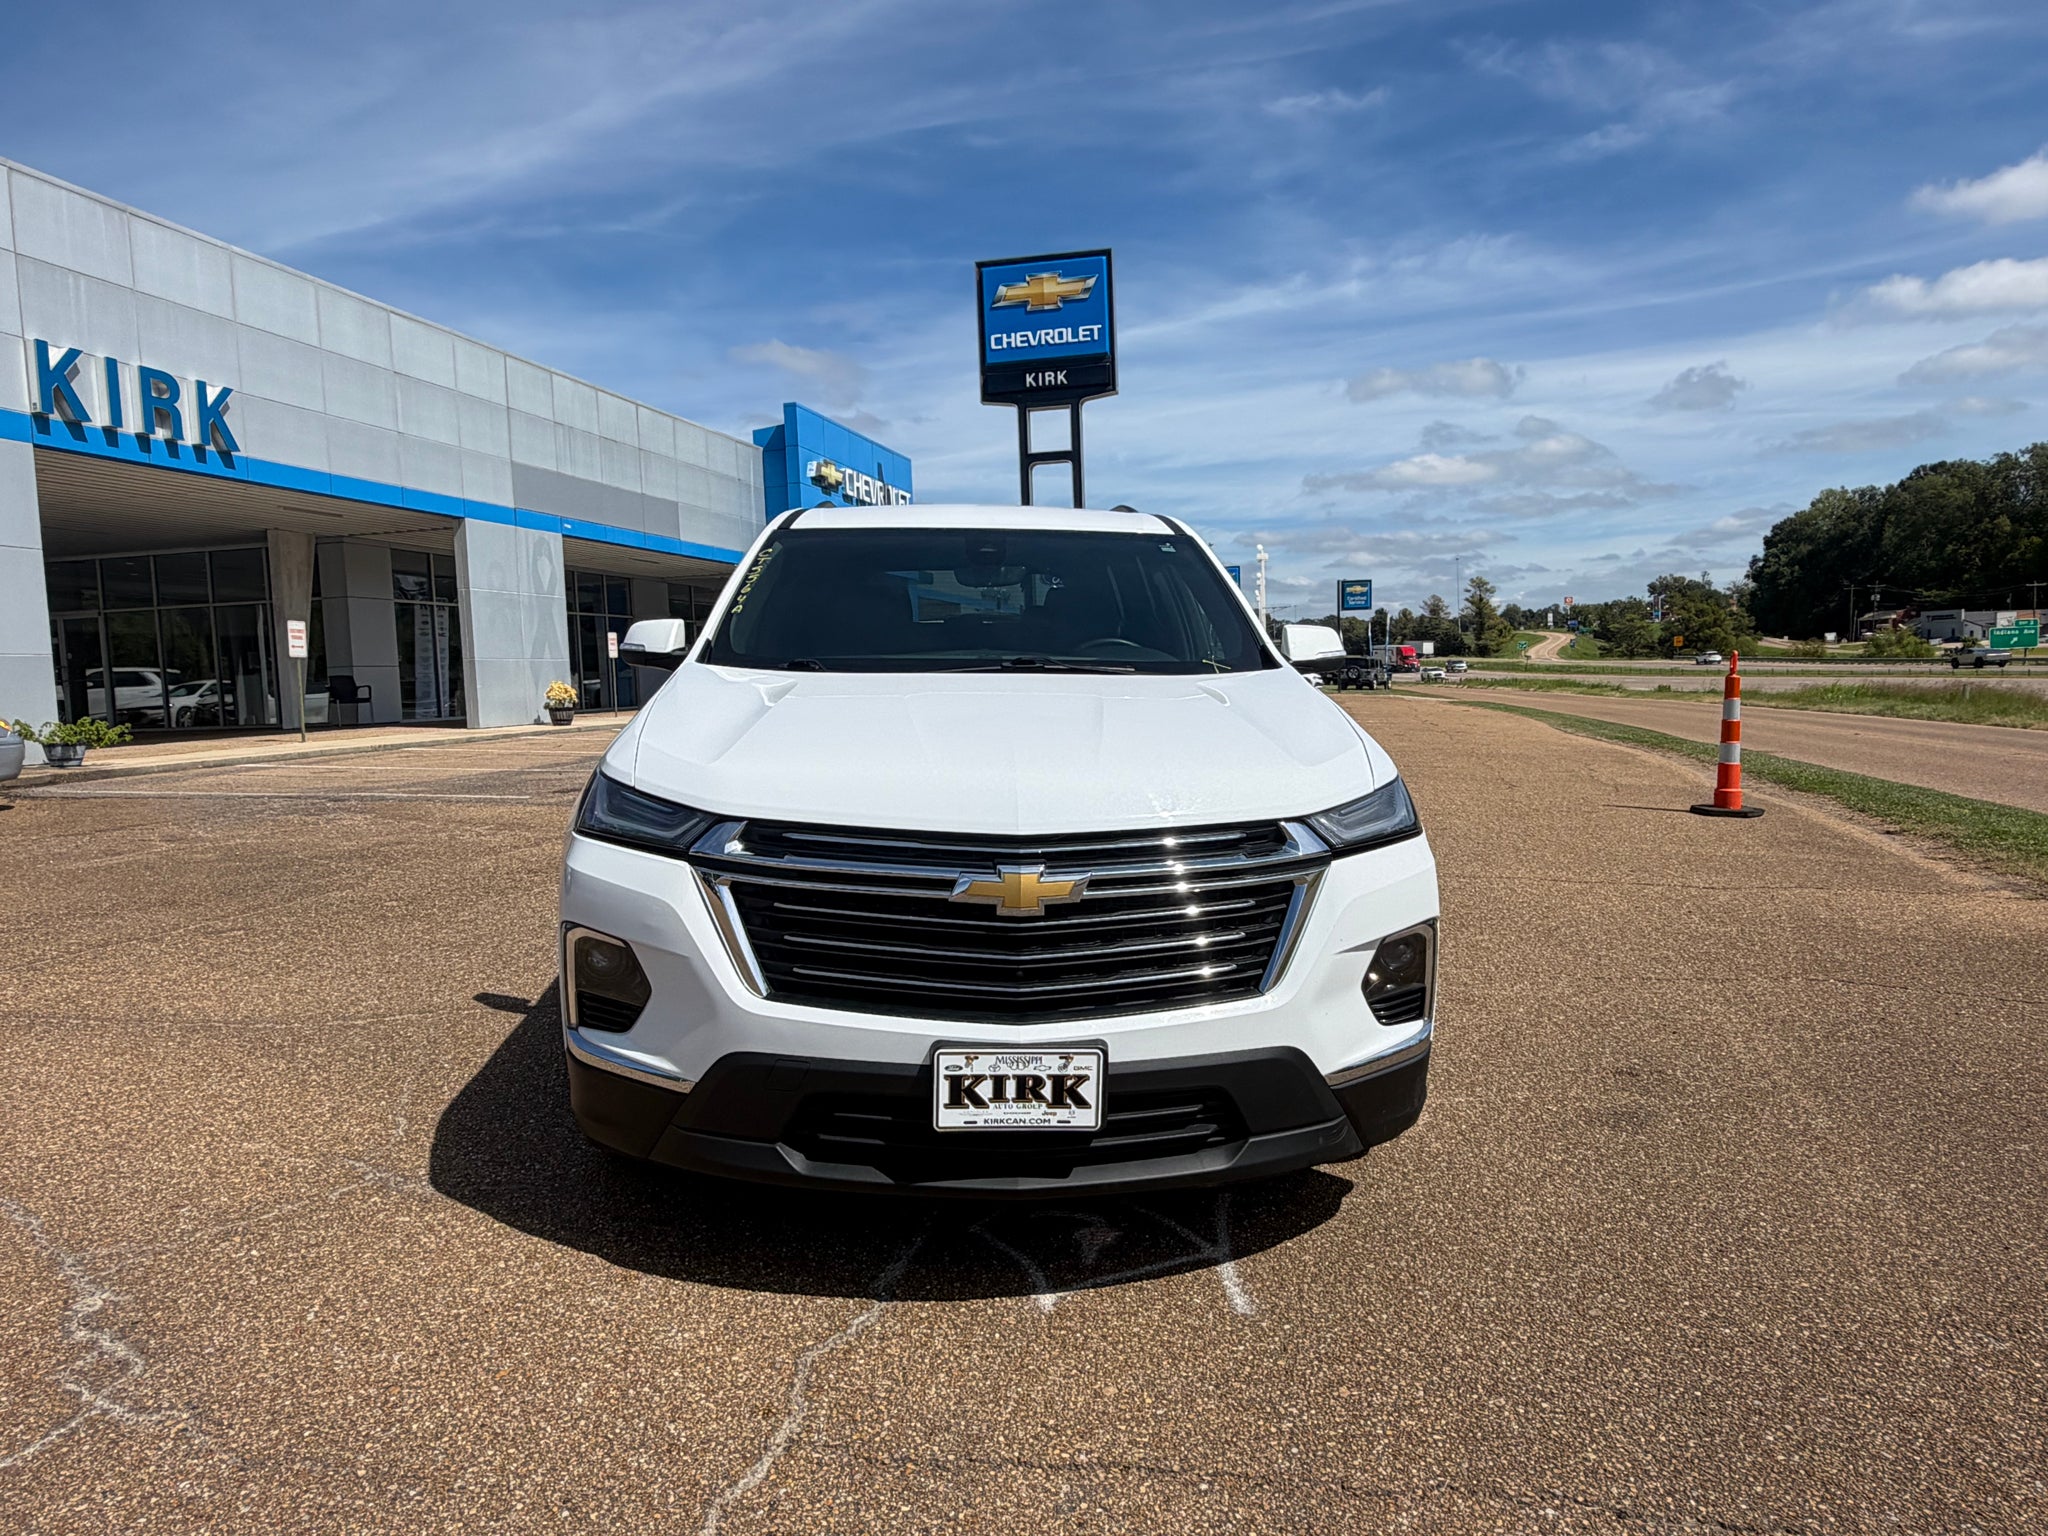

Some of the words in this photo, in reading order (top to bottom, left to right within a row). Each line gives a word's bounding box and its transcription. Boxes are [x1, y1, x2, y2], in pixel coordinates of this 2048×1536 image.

[990, 325, 1102, 350] CHEVROLET
[1025, 369, 1068, 388] KIRK
[33, 338, 241, 453] KIRK
[995, 1055, 1043, 1070] MISSISSIPPI
[943, 1073, 1092, 1109] KIRK
[983, 1117, 1051, 1125] KIRKCAN.COM
